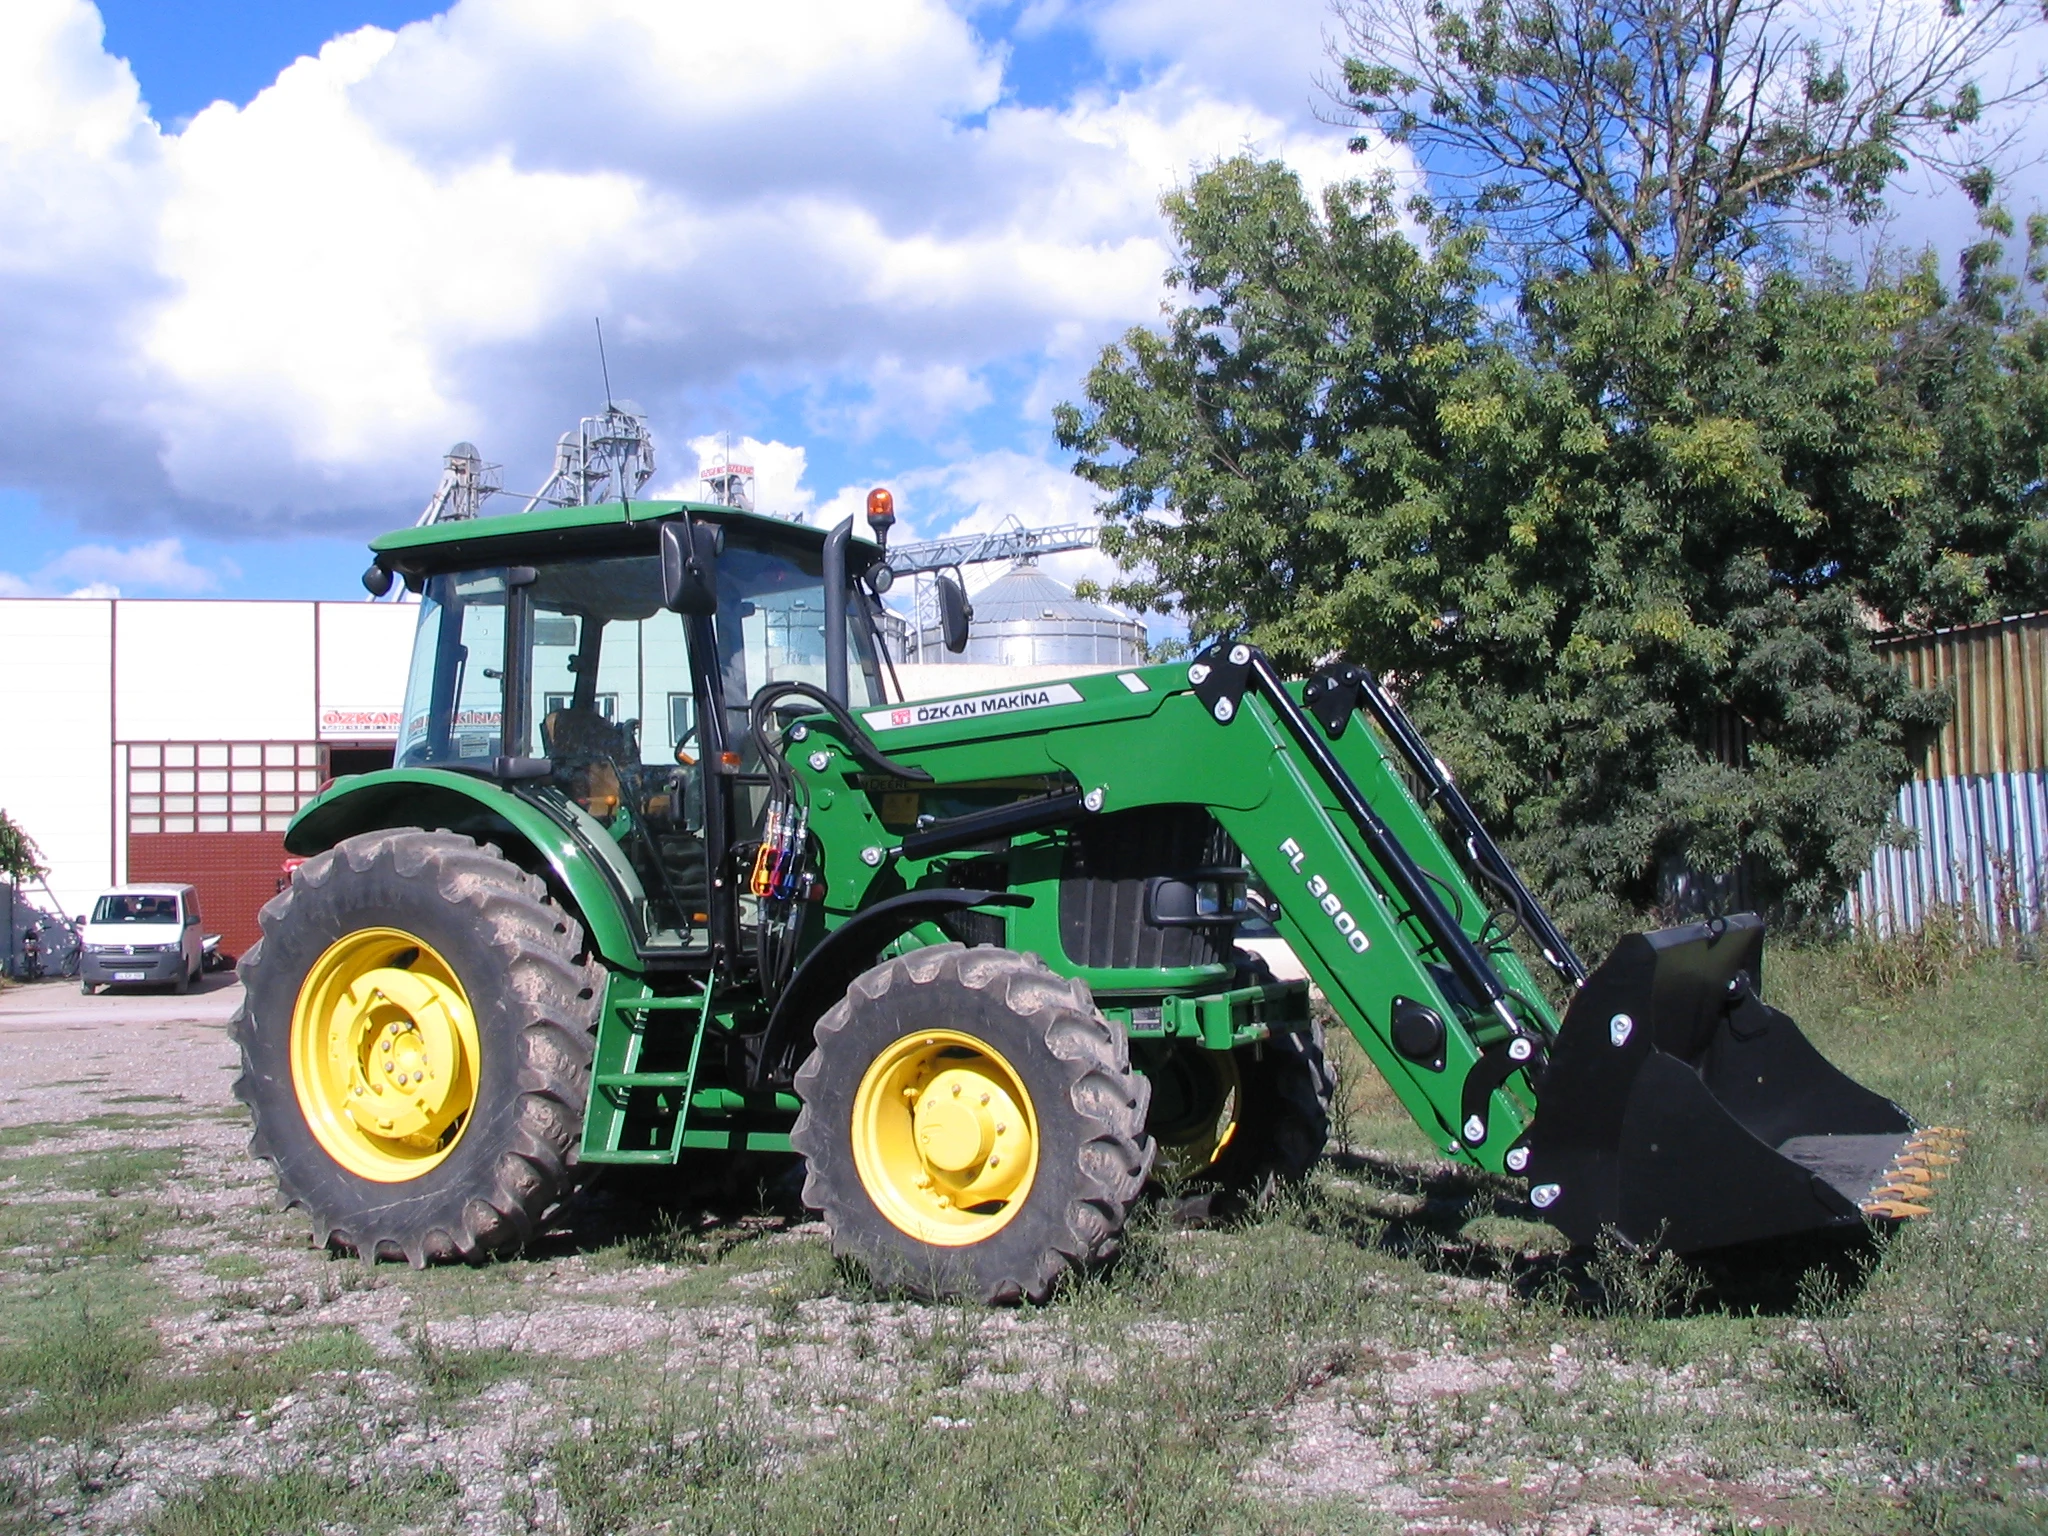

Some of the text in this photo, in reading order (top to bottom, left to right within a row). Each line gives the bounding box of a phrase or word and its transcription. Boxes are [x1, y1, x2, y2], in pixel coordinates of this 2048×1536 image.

[917, 691, 1050, 722] ÖZKAN MAKİNA
[1277, 836, 1371, 954] FL 3800
